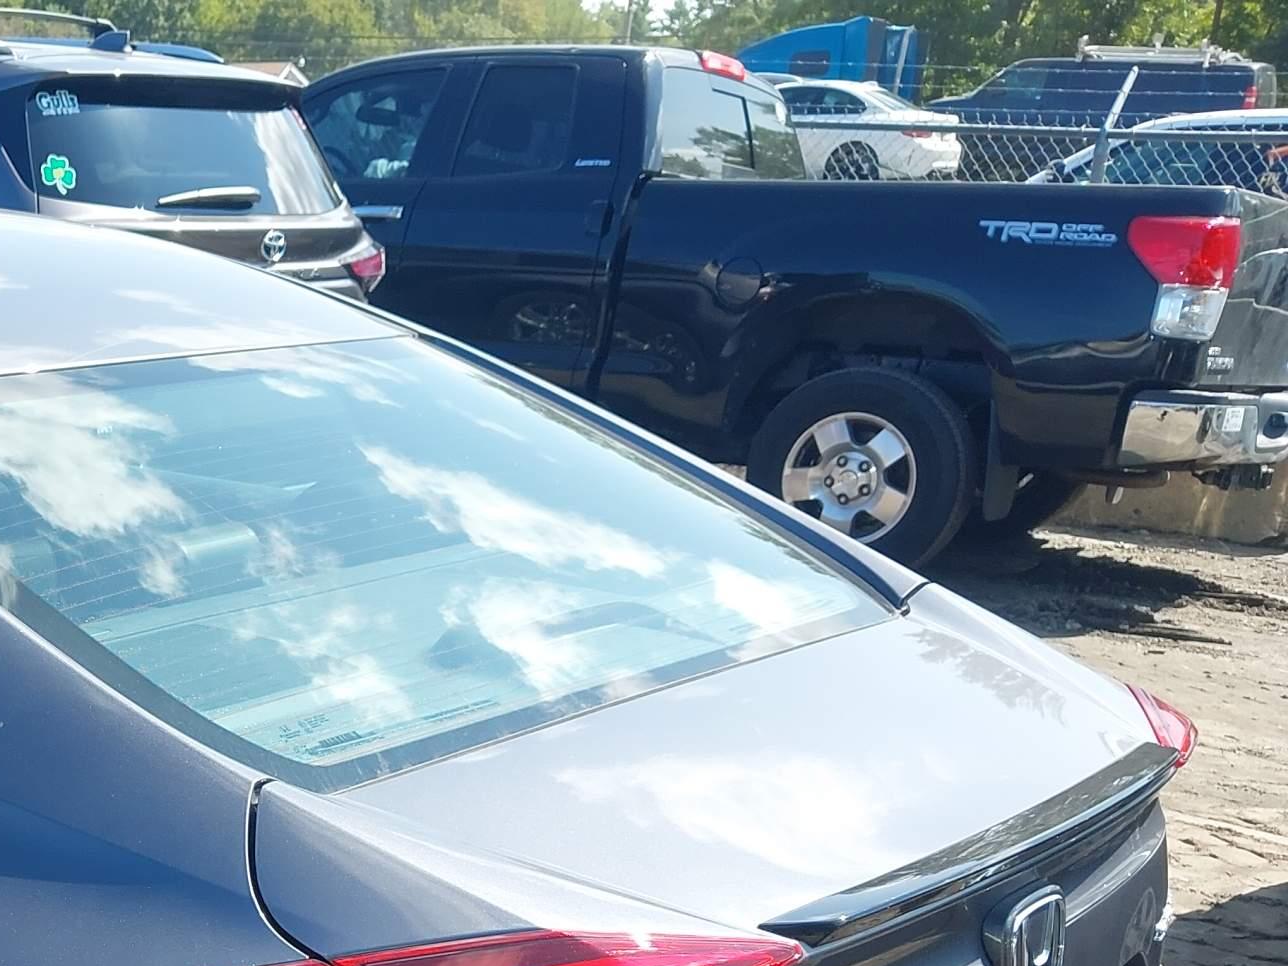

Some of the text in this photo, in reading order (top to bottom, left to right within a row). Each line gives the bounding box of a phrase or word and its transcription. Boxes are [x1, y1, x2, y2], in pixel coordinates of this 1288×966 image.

[978, 220, 1060, 244] TRD
[1061, 223, 1105, 232] OFF
[1059, 231, 1118, 243] ROAD
